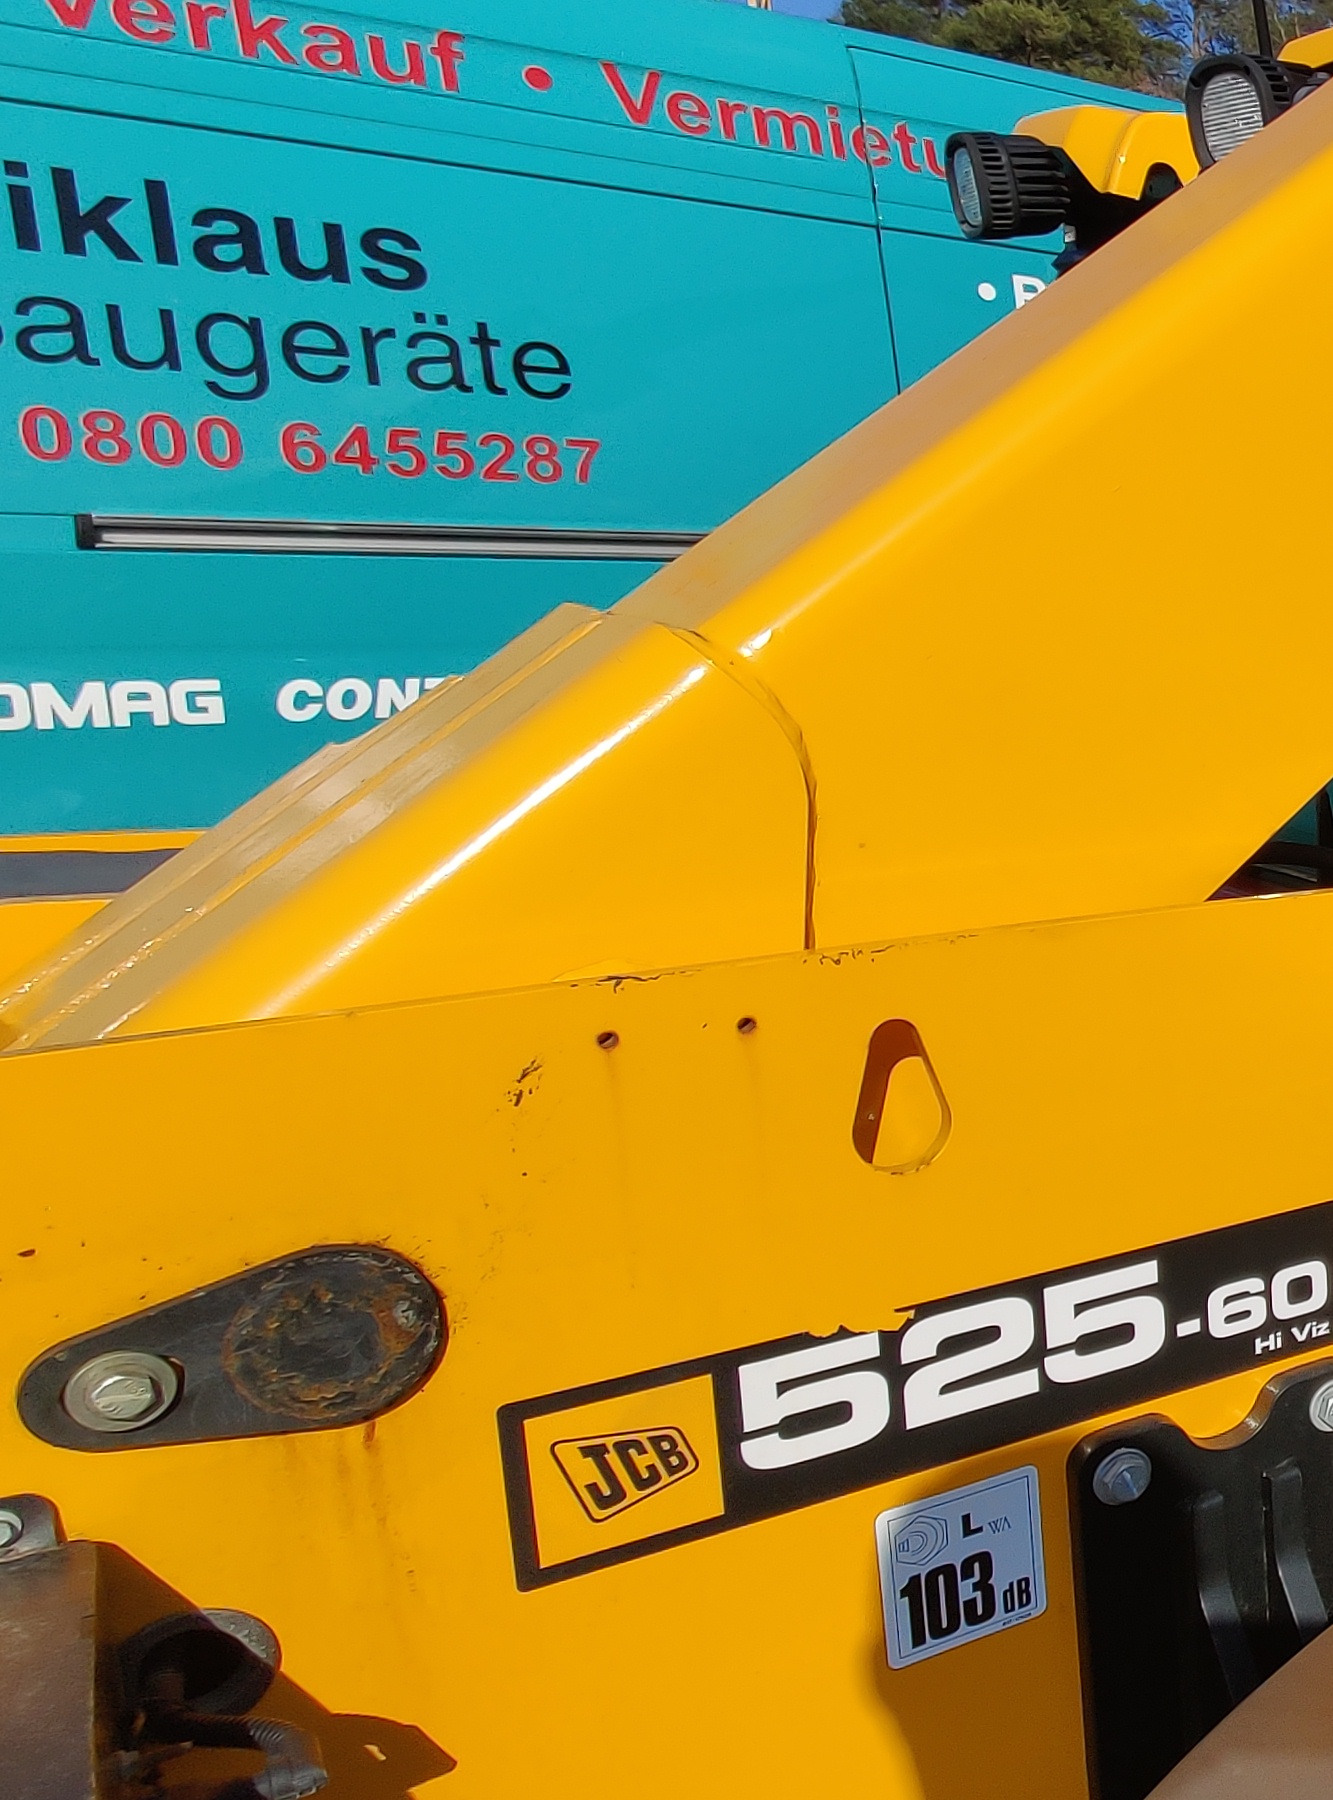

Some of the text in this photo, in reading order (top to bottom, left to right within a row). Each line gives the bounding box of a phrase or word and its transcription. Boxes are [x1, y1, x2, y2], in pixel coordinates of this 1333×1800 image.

[0, 296, 572, 400] augeräte
[19, 405, 601, 484] 0800 6455287
[275, 678, 445, 723] CON
[737, 1260, 1330, 1472] 525-60
[1254, 1318, 1331, 1357] Hi Viz
[583, 1433, 690, 1512] JCB
[961, 1512, 1012, 1539] L WA
[899, 1550, 1031, 1650] 103 dB
